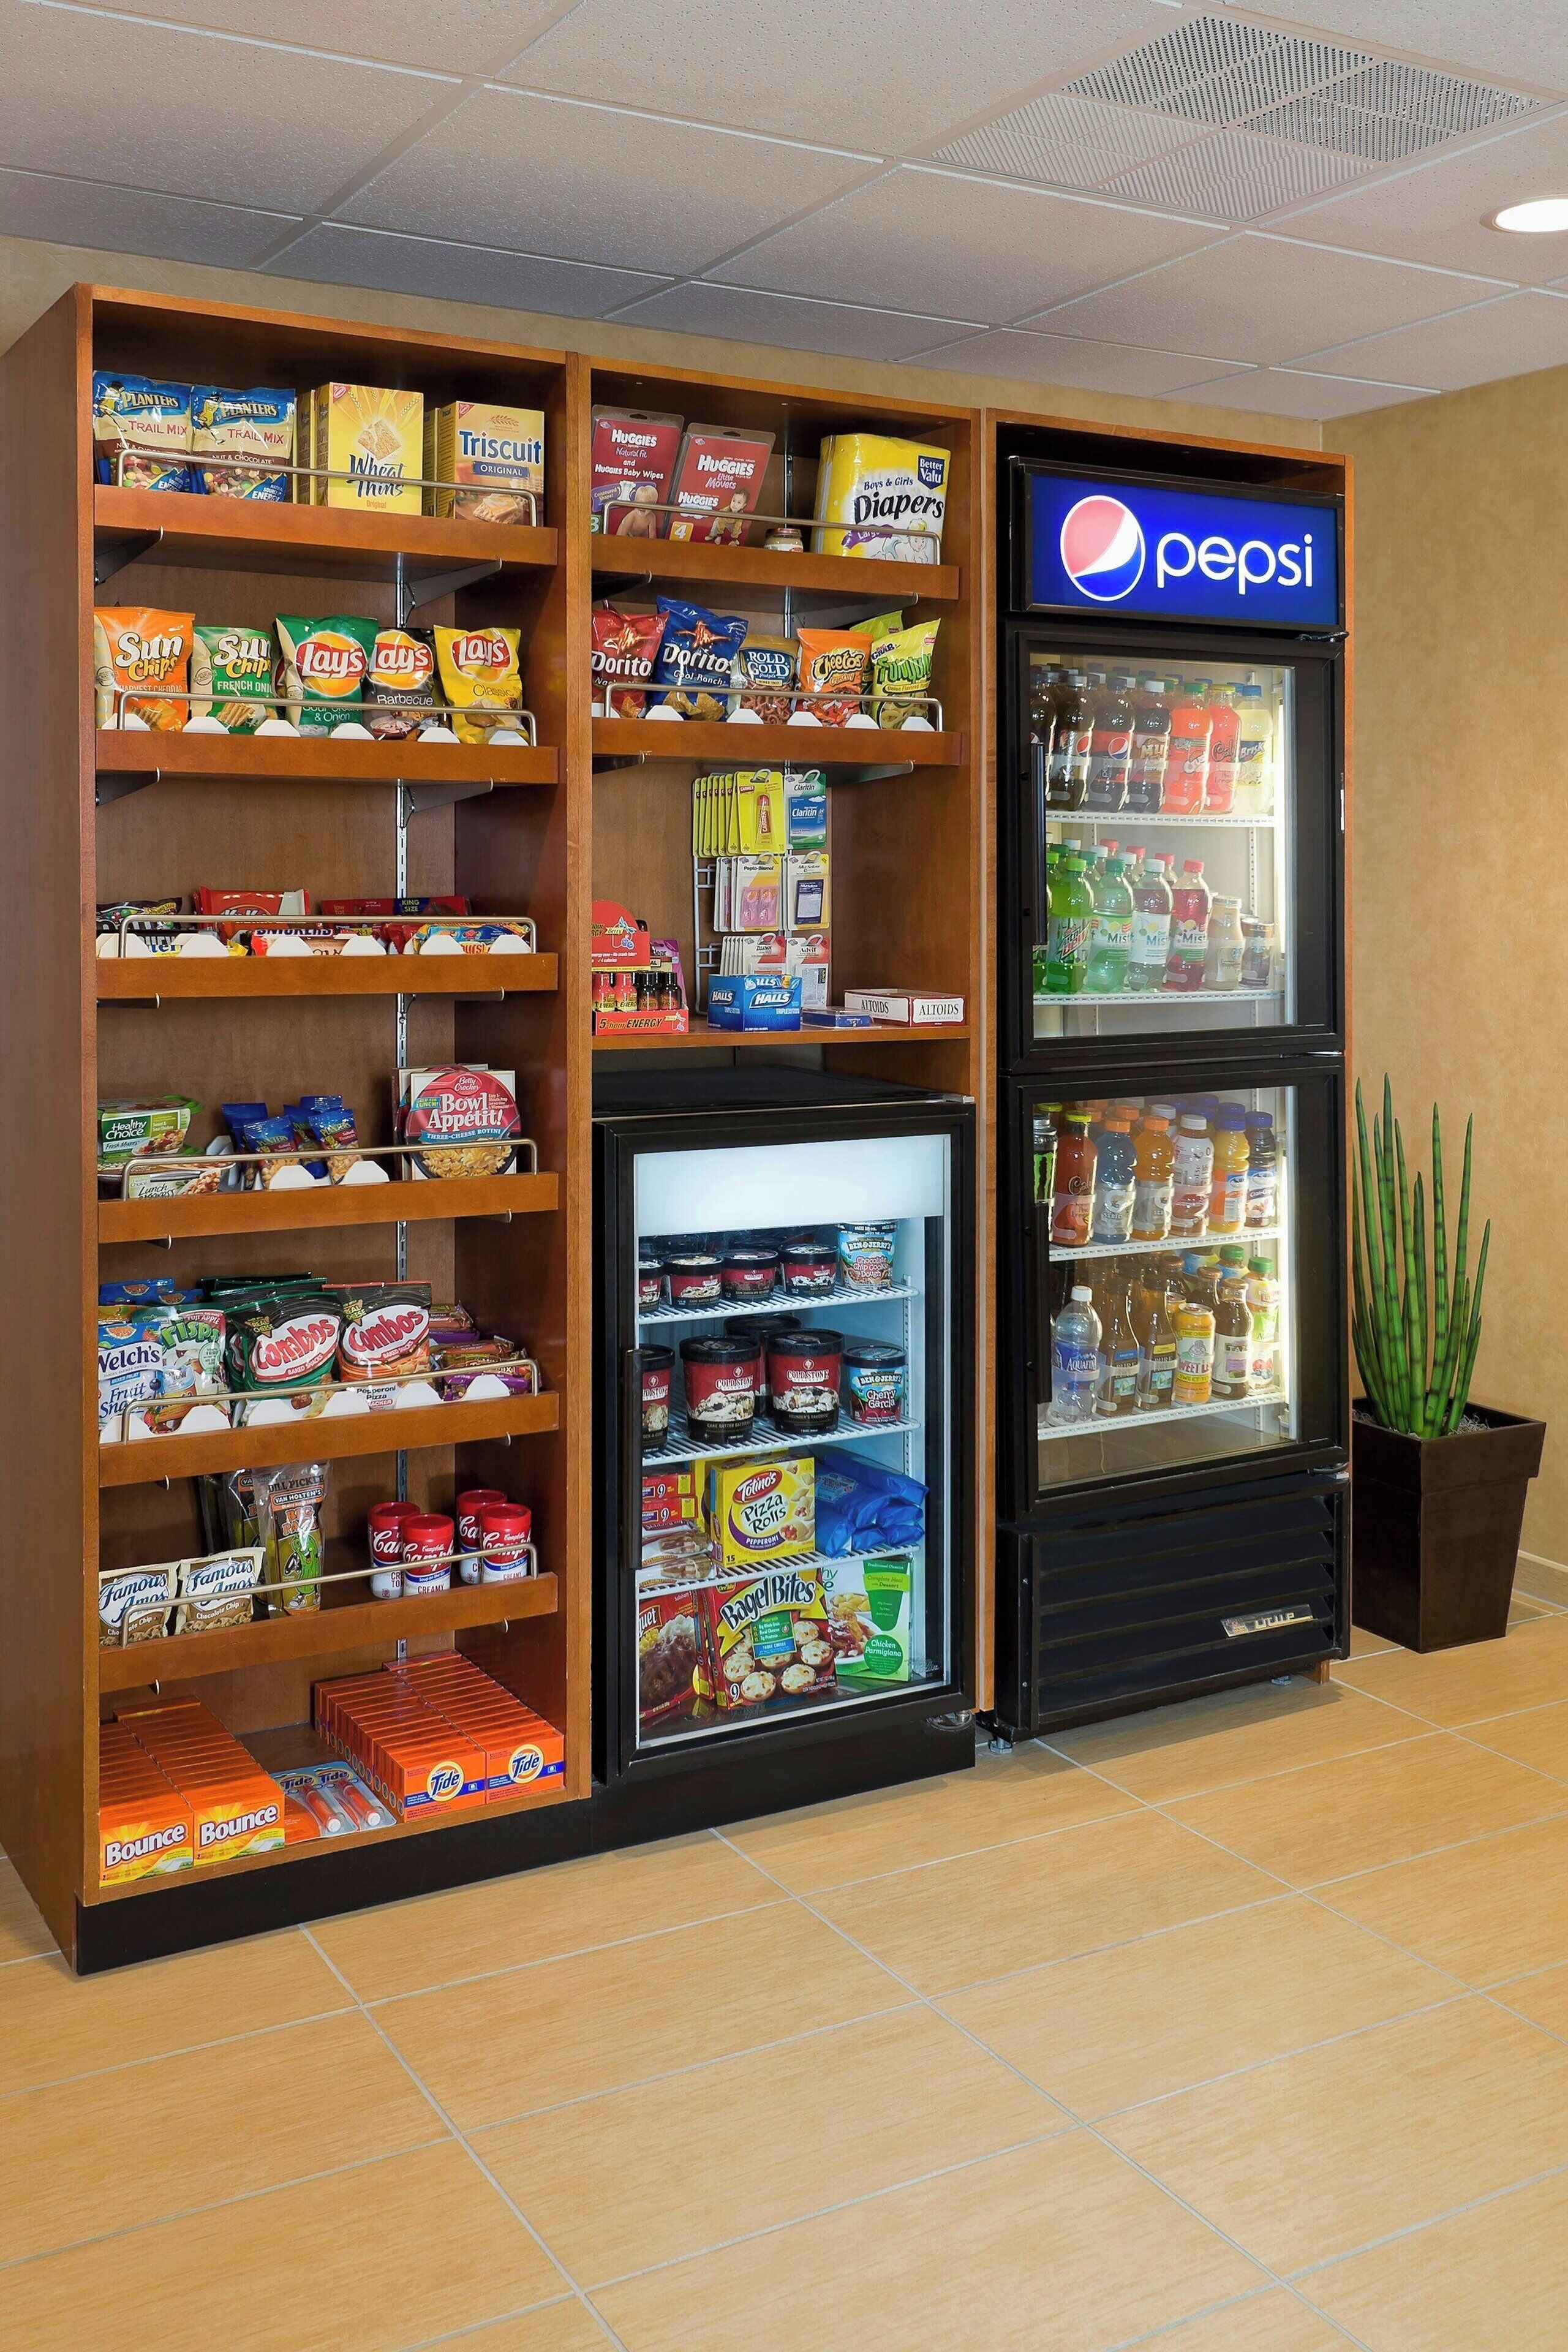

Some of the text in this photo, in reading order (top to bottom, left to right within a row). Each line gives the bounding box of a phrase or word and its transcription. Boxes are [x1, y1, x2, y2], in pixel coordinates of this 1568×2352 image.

[123, 391, 179, 408] PLANTERS
[221, 401, 277, 418] PLANTERS
[128, 420, 187, 436] TRAIL MIX
[227, 429, 285, 445] TRAIL MIX
[612, 429, 657, 447] HUGGIES
[458, 430, 542, 465] Triscuit
[616, 447, 639, 458] Natural
[235, 455, 273, 465] CHOCOLATE
[347, 453, 407, 480] Wheat
[698, 454, 754, 476] HUGGIES
[919, 458, 943, 470] Better
[480, 465, 523, 477] ORIGINAL
[595, 464, 664, 480] HUGGIES Baby Wipes
[920, 469, 942, 484] Valu
[347, 480, 405, 498] Thins
[706, 477, 737, 489] Movers
[864, 477, 913, 491] Boys & Girls
[366, 500, 386, 509] Original
[678, 491, 719, 507] HUGGIES
[854, 492, 944, 525] Diapers
[674, 524, 687, 540] 4
[1157, 532, 1313, 595] pepsi
[115, 632, 184, 668] Sun
[213, 635, 271, 667] Sun
[458, 635, 510, 668] Lay's
[748, 651, 785, 664] ROLD
[871, 643, 895, 660] GRAB
[308, 642, 364, 679] Lay's
[592, 650, 652, 677] Dorito
[812, 650, 865, 679] Cheetos
[128, 658, 178, 681] Chips
[227, 658, 271, 679] Chips
[747, 662, 789, 677] GOLD
[674, 670, 723, 686] Cool Ranch
[830, 673, 855, 686] Crunchy
[217, 681, 253, 691] FRENCH
[472, 684, 514, 698] Classic
[377, 695, 434, 707] Barbecue
[314, 712, 350, 722] & Onion
[792, 808, 817, 817] Claritin
[712, 991, 733, 1001] HALLS
[755, 992, 791, 1005] HALLS
[861, 1000, 889, 1014] ALTOIDS
[919, 1003, 960, 1016] ALTOIDS
[627, 1018, 662, 1028] ENERGY
[459, 1076, 477, 1086] Betty
[440, 1093, 489, 1114] Bowl
[112, 1119, 148, 1132] Healthy
[426, 1109, 504, 1132] Appétit!
[105, 1128, 145, 1140] Choice
[256, 1136, 288, 1147] PLANTERS
[426, 1130, 476, 1140] THREE-CHEESE
[138, 1183, 168, 1196] Lunch
[345, 1305, 363, 1314] REAL
[346, 1310, 367, 1321] CHEESE
[201, 1315, 221, 1325] APPLE
[254, 1324, 275, 1333] CHEESE
[349, 1311, 424, 1352] Combos
[257, 1319, 335, 1369] Combos
[383, 1349, 399, 1358] BAKED
[287, 1365, 306, 1375] BAKED
[1066, 1356, 1096, 1373] AQUAFIN
[715, 1375, 753, 1390] COLD STONE
[787, 1369, 829, 1381] COLD STONE
[110, 1383, 147, 1403] Fruit
[866, 1389, 896, 1400] Cherry
[868, 1399, 895, 1409] Garcia
[268, 1474, 325, 1493] DILL PICKLE
[657, 1484, 665, 1498] 9
[737, 1471, 777, 1502] Totino's
[289, 1489, 321, 1501] HOLTEN'S
[286, 1506, 314, 1522] BIG
[661, 1507, 669, 1522] 9
[741, 1494, 783, 1522] Pizza
[749, 1507, 786, 1534] Rolls
[746, 1535, 779, 1545] PEPPERONI
[186, 1558, 254, 1591] Famous
[99, 1572, 167, 1610] Famous
[418, 1584, 445, 1594] CREAMY
[720, 1572, 815, 1630] Bagel Bites
[196, 1602, 239, 1619] Chocolate Chip
[138, 1616, 153, 1626] Chip
[865, 1645, 902, 1657] Parmigiana
[871, 1639, 895, 1649] Chicken
[730, 1683, 740, 1702] 9
[513, 1754, 541, 1777] Tide
[280, 1776, 314, 1790] Tide
[317, 1769, 350, 1784] Tide
[431, 1772, 460, 1795] Tide
[200, 1805, 277, 1847] Bounce
[106, 1825, 186, 1868] Bounce
